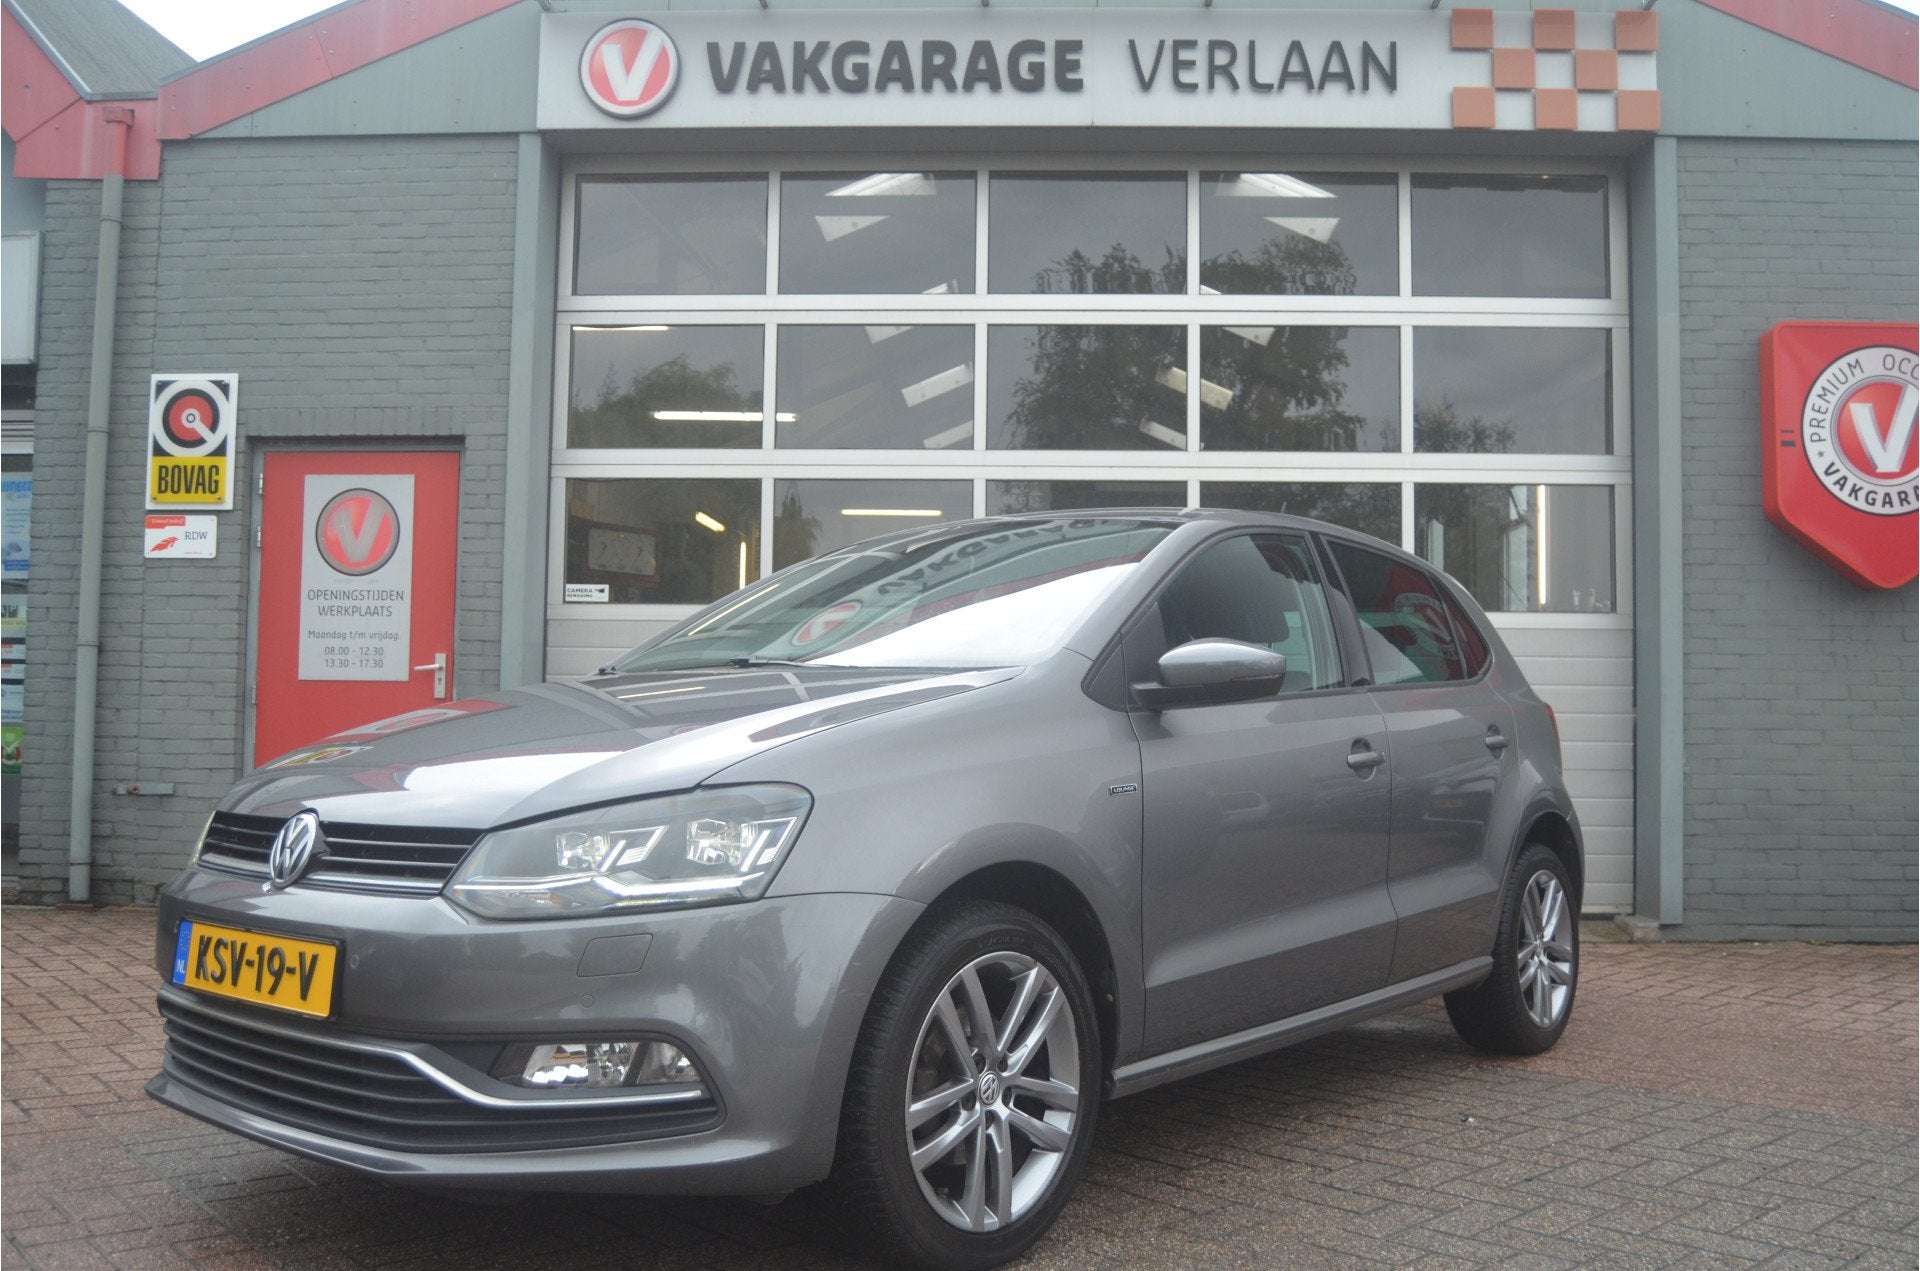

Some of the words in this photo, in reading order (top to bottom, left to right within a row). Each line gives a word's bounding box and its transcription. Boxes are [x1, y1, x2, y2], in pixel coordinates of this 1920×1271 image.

[706, 39, 1085, 93] VAKGARAGE
[1128, 38, 1398, 93] VERLAAN
[1809, 357, 1865, 444] PREMIUM
[157, 464, 220, 495] BOVAG
[184, 531, 209, 540] RDW
[307, 589, 404, 601] OPENINGSTIJDEN
[318, 605, 393, 617] WERKPLAATS
[308, 630, 347, 640] Maandag
[349, 630, 367, 640] t/m
[324, 646, 350, 656] 08.00
[359, 646, 384, 656] 12.30
[324, 659, 349, 668] 13.30
[359, 659, 384, 668] 17.30
[176, 958, 186, 974] NL
[194, 934, 320, 1002] KSV-19-V
